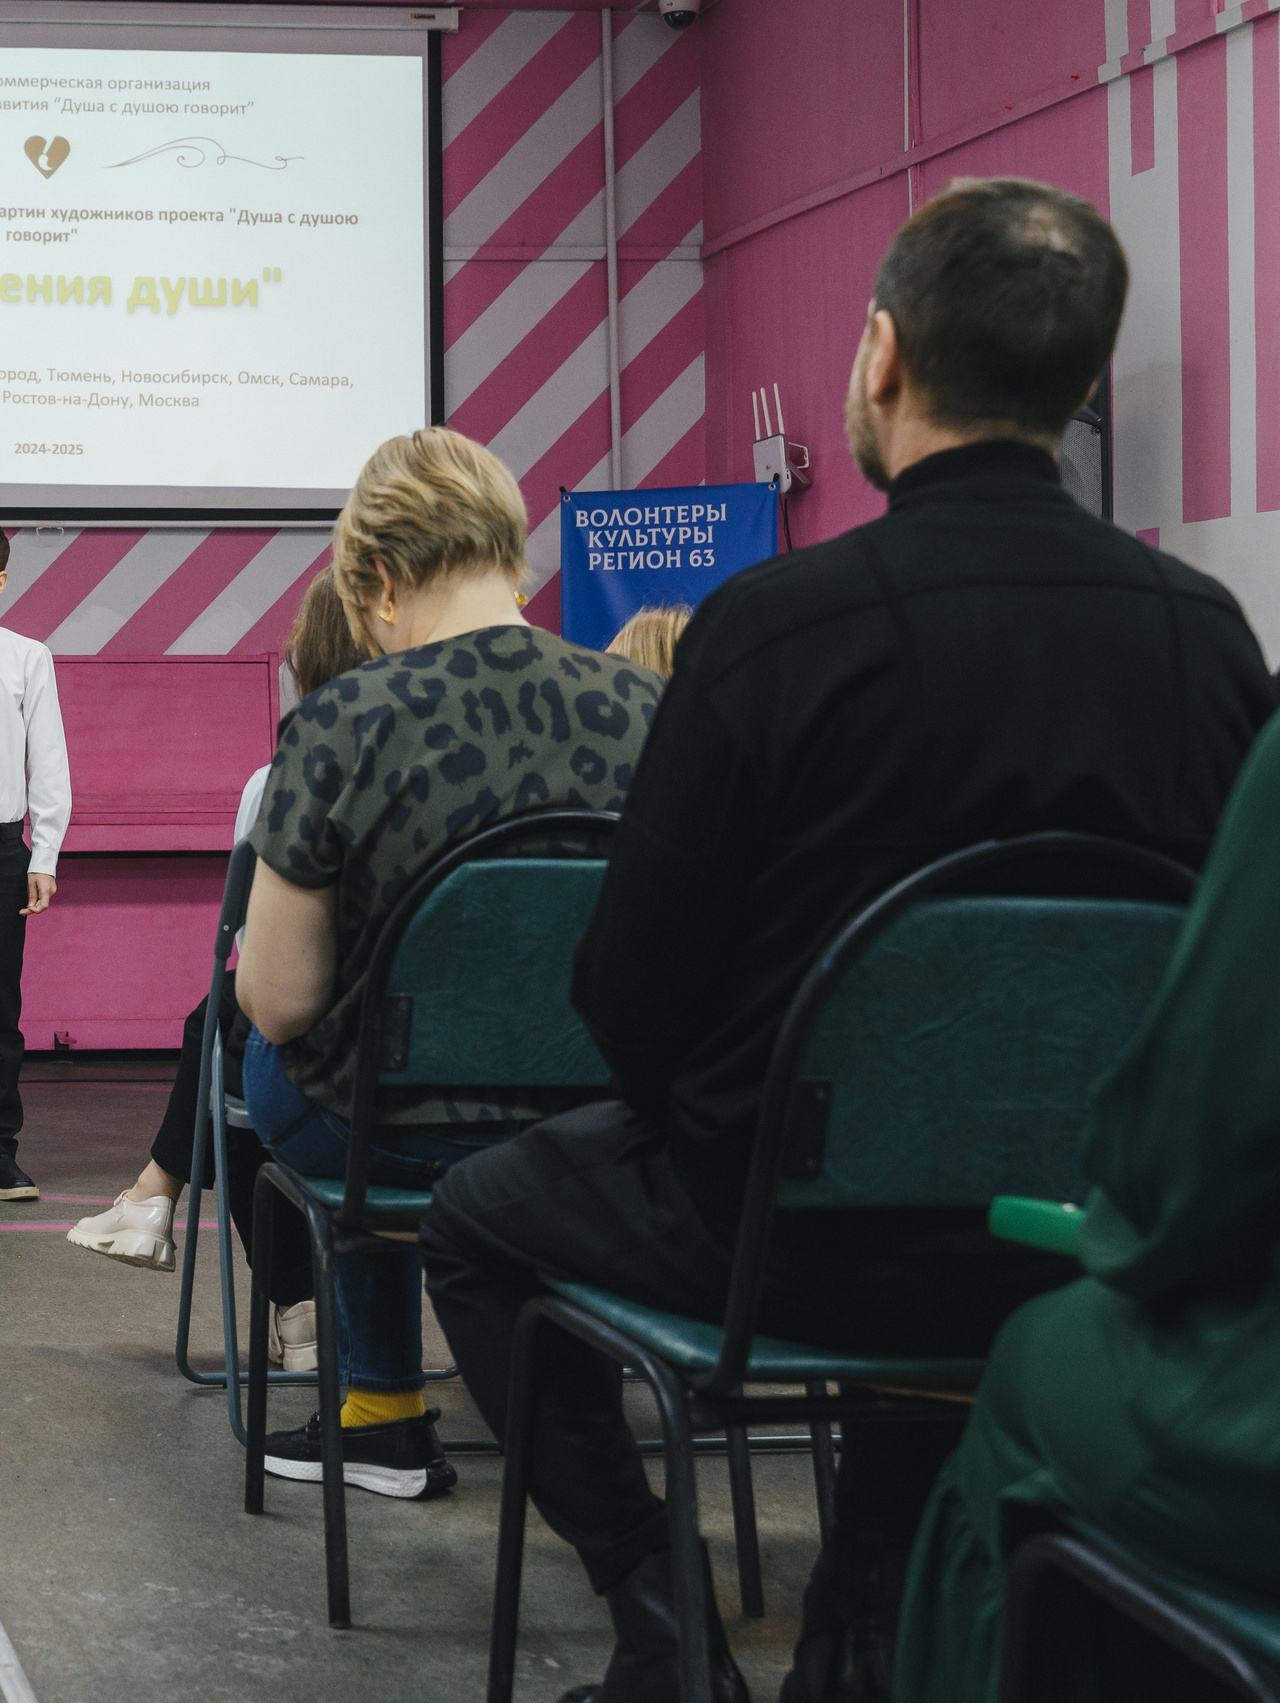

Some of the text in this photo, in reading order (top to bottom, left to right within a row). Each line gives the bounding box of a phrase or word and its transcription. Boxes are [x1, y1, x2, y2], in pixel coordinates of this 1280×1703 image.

[108, 80, 210, 93] организация
[109, 102, 118, 113] с
[122, 103, 179, 115] душою
[51, 209, 153, 222] художников
[159, 211, 224, 224] проекта
[288, 213, 295, 224] с
[300, 214, 358, 227] душою
[47, 368, 115, 384] Тюмень,
[122, 369, 232, 386] Новосибирск,
[238, 371, 284, 387] Омск,
[289, 372, 353, 389] Самара,
[3, 390, 133, 409] Ростов-на-Дону,
[139, 394, 199, 407] Москва
[15, 443, 83, 455] 2024-2025
[575, 503, 727, 528] ВОЛОНТЕРЫ
[588, 525, 714, 549] КУЛЬТУРЫ
[589, 549, 714, 570] РЕГИОН 63
